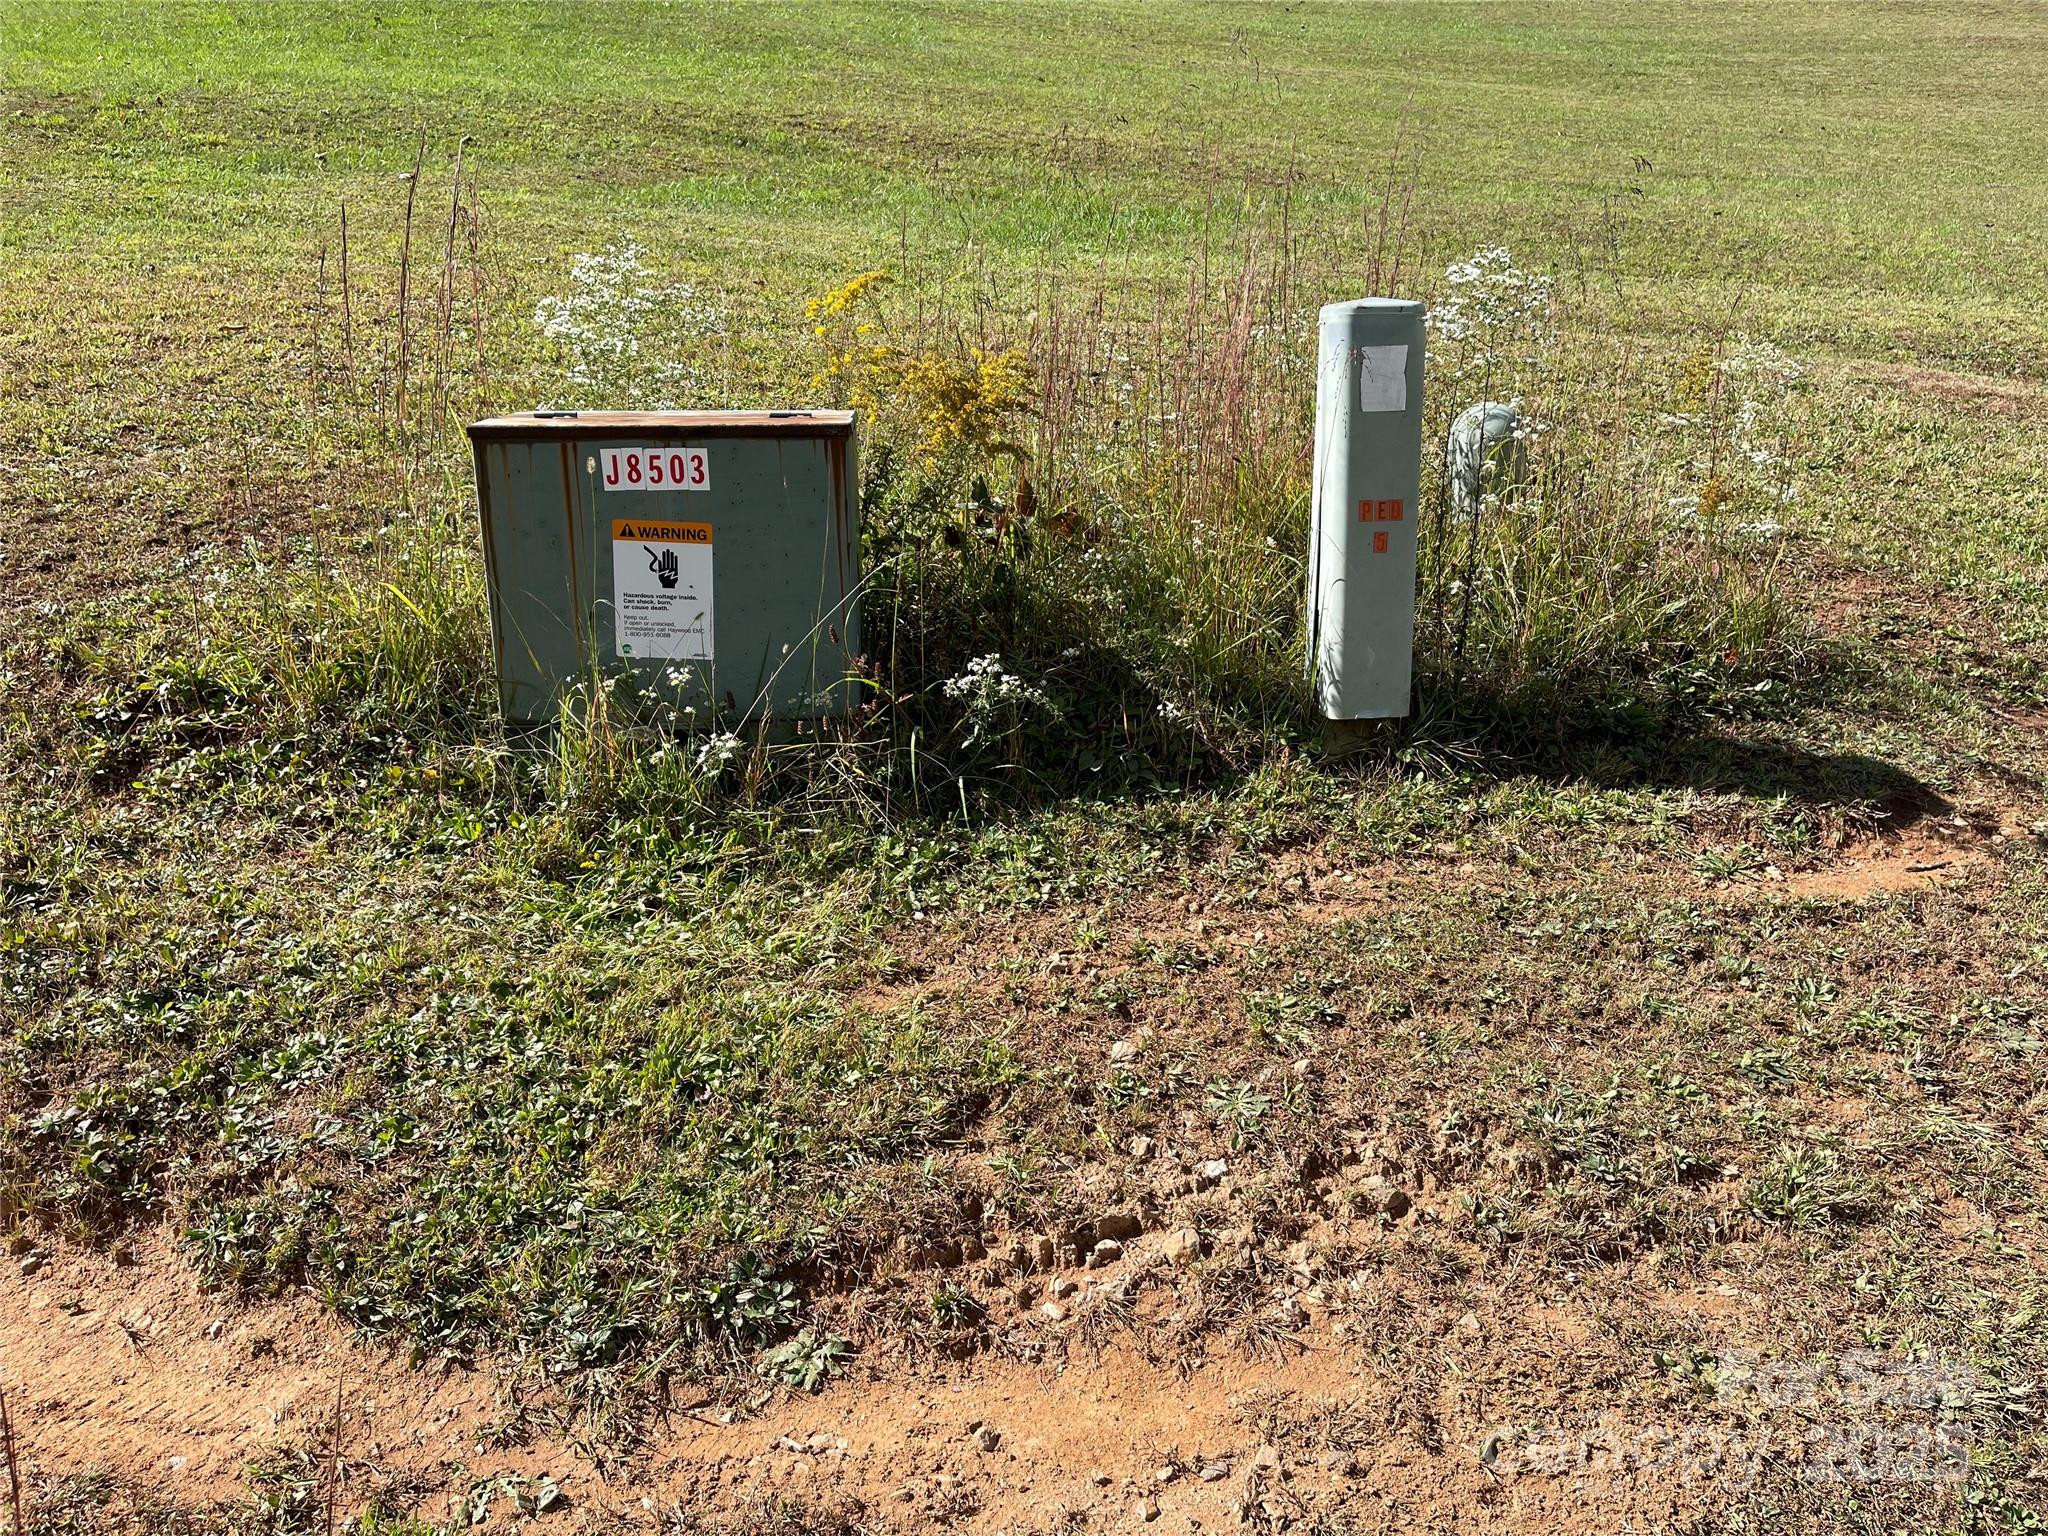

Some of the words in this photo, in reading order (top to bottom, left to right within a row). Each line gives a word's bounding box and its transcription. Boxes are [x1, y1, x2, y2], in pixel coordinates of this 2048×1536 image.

[606, 453, 705, 485] J8503
[1362, 501, 1401, 520] PED
[637, 526, 707, 541] WARNING
[1375, 532, 1386, 552] 5
[655, 593, 677, 601] voltage
